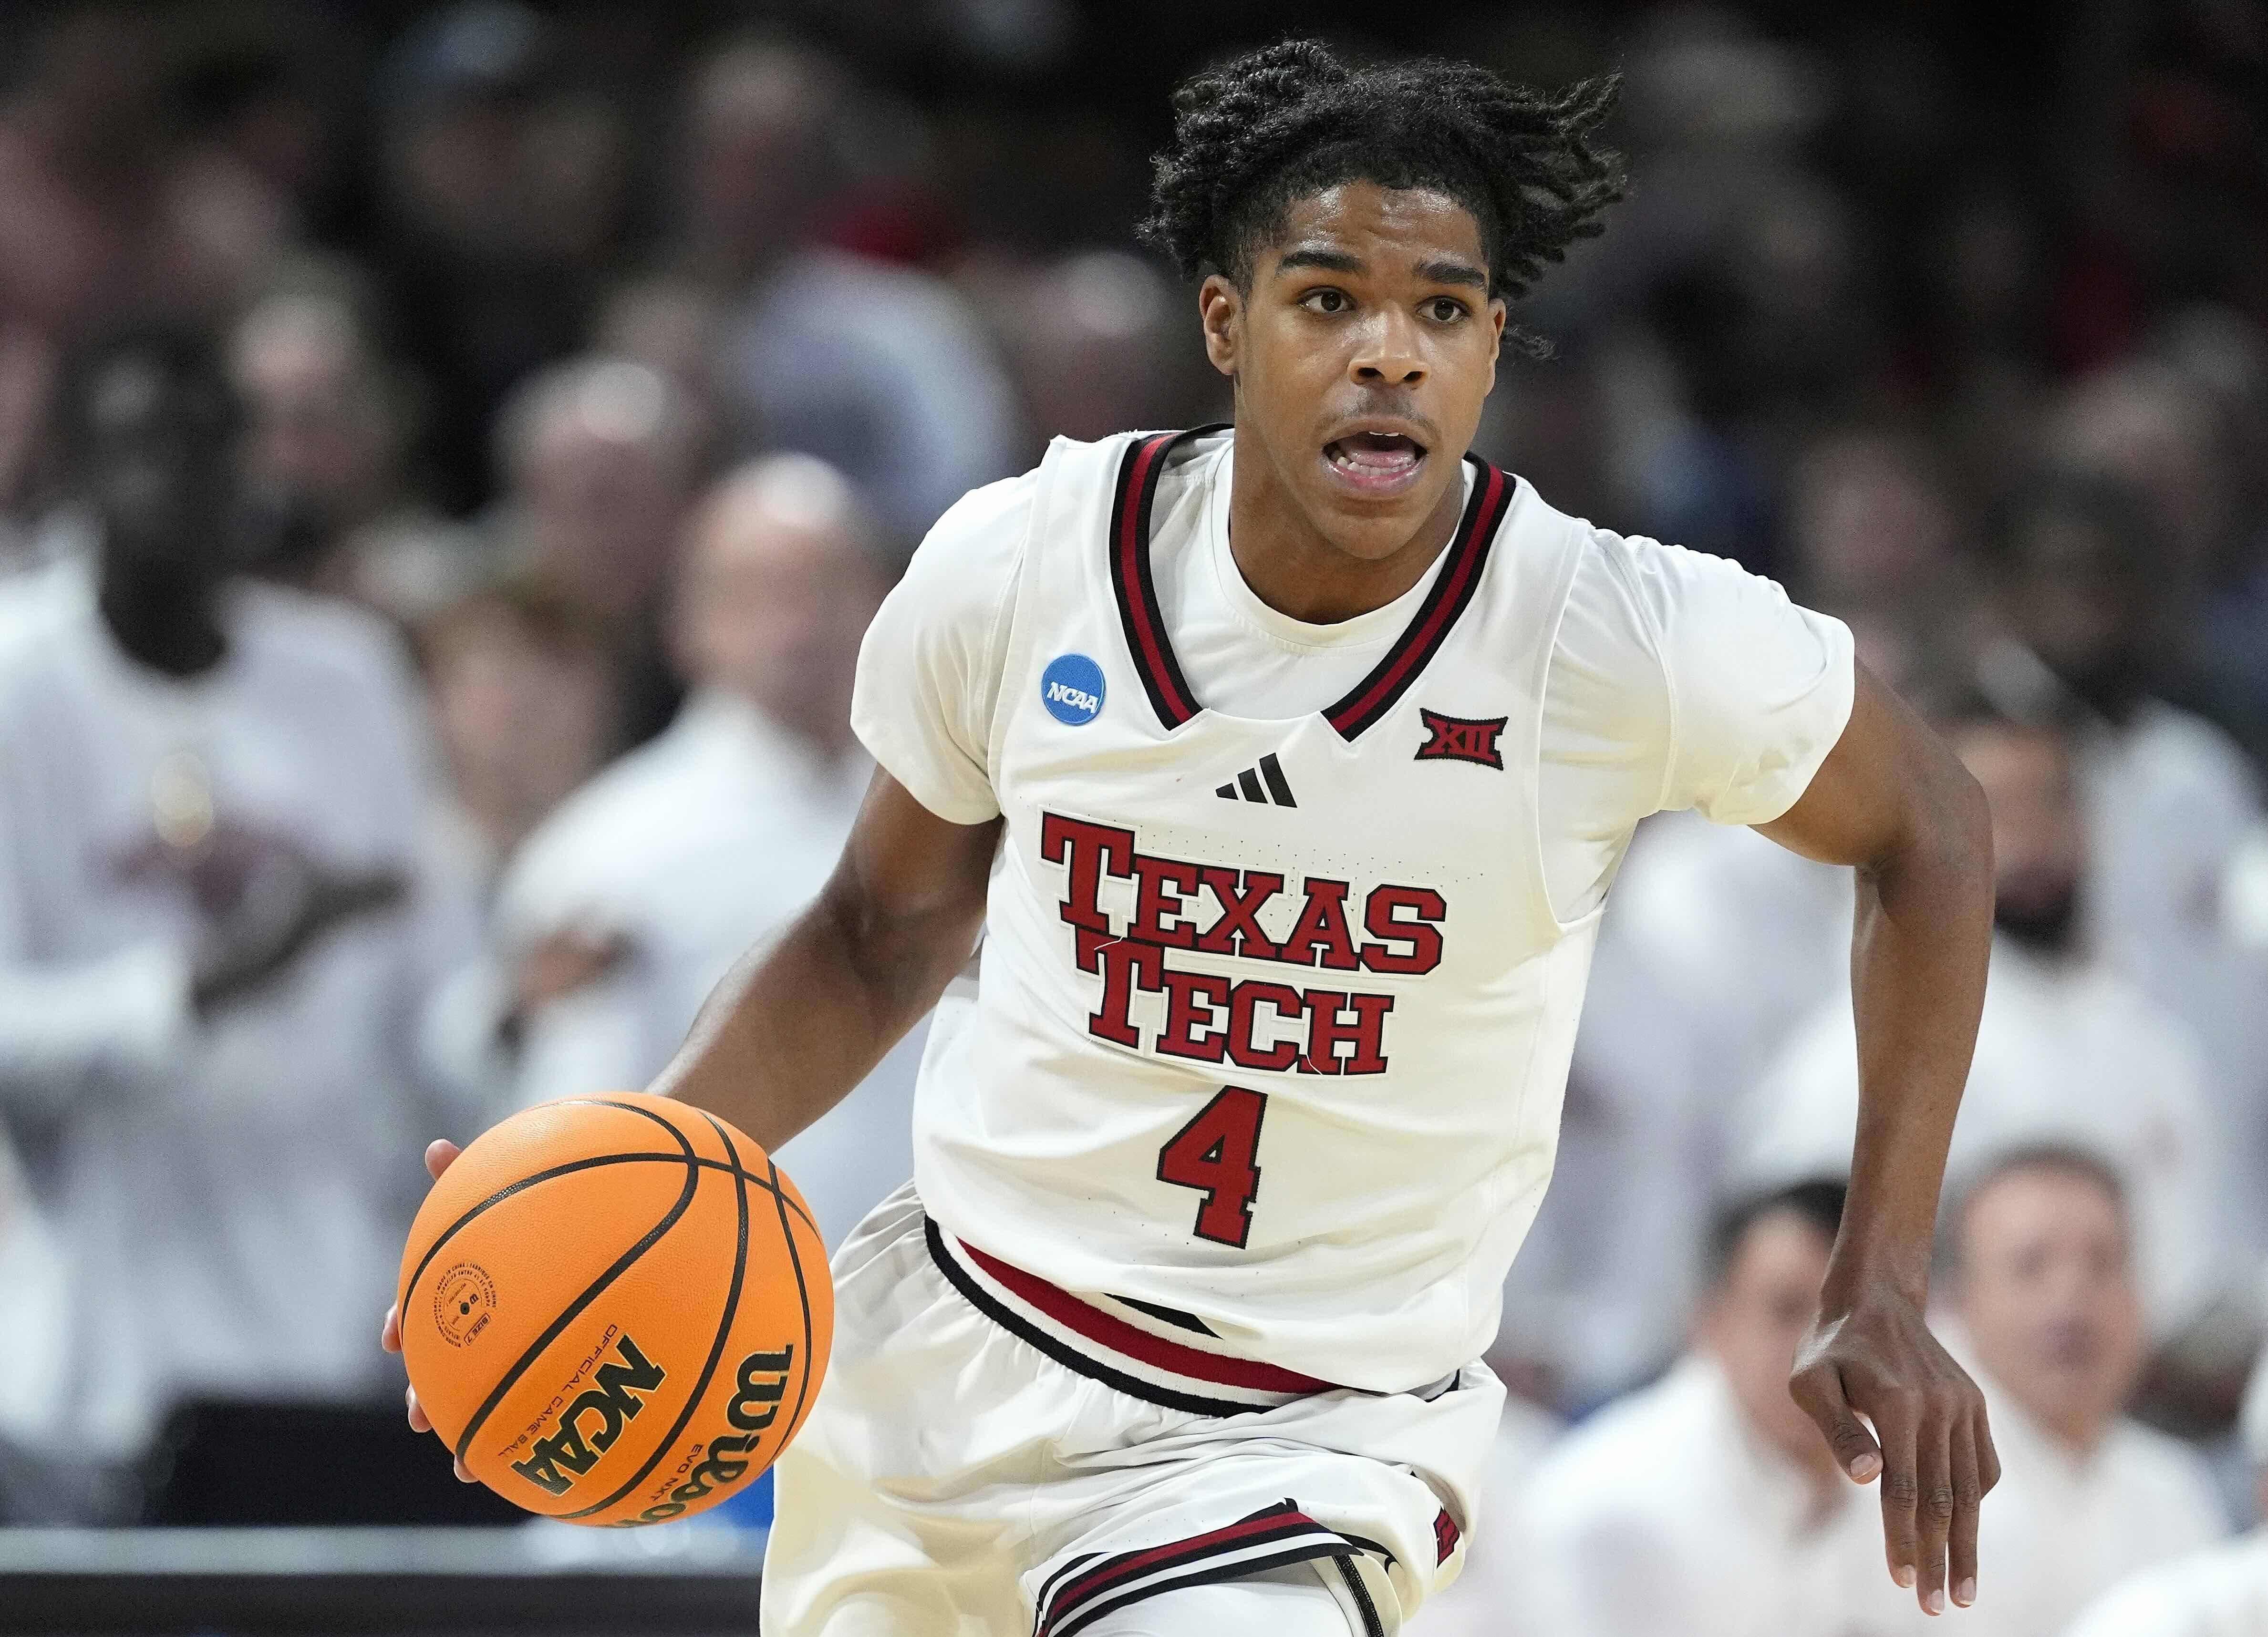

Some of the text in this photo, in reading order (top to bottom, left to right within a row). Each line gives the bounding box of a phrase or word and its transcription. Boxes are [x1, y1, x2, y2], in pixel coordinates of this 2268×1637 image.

[1046, 681, 1098, 713] NCAA
[1423, 717, 1500, 762] XII
[1041, 811, 1447, 975] TEXAS
[1074, 926, 1395, 1076] TECH
[1156, 1084, 1268, 1250] 4
[452, 1263, 465, 1271] CHINA
[472, 1317, 488, 1336] SIZE
[498, 1324, 618, 1456] OFFICIAL GAME BALL
[510, 1332, 668, 1497] NCAA
[651, 1443, 704, 1502] EVO NXT
